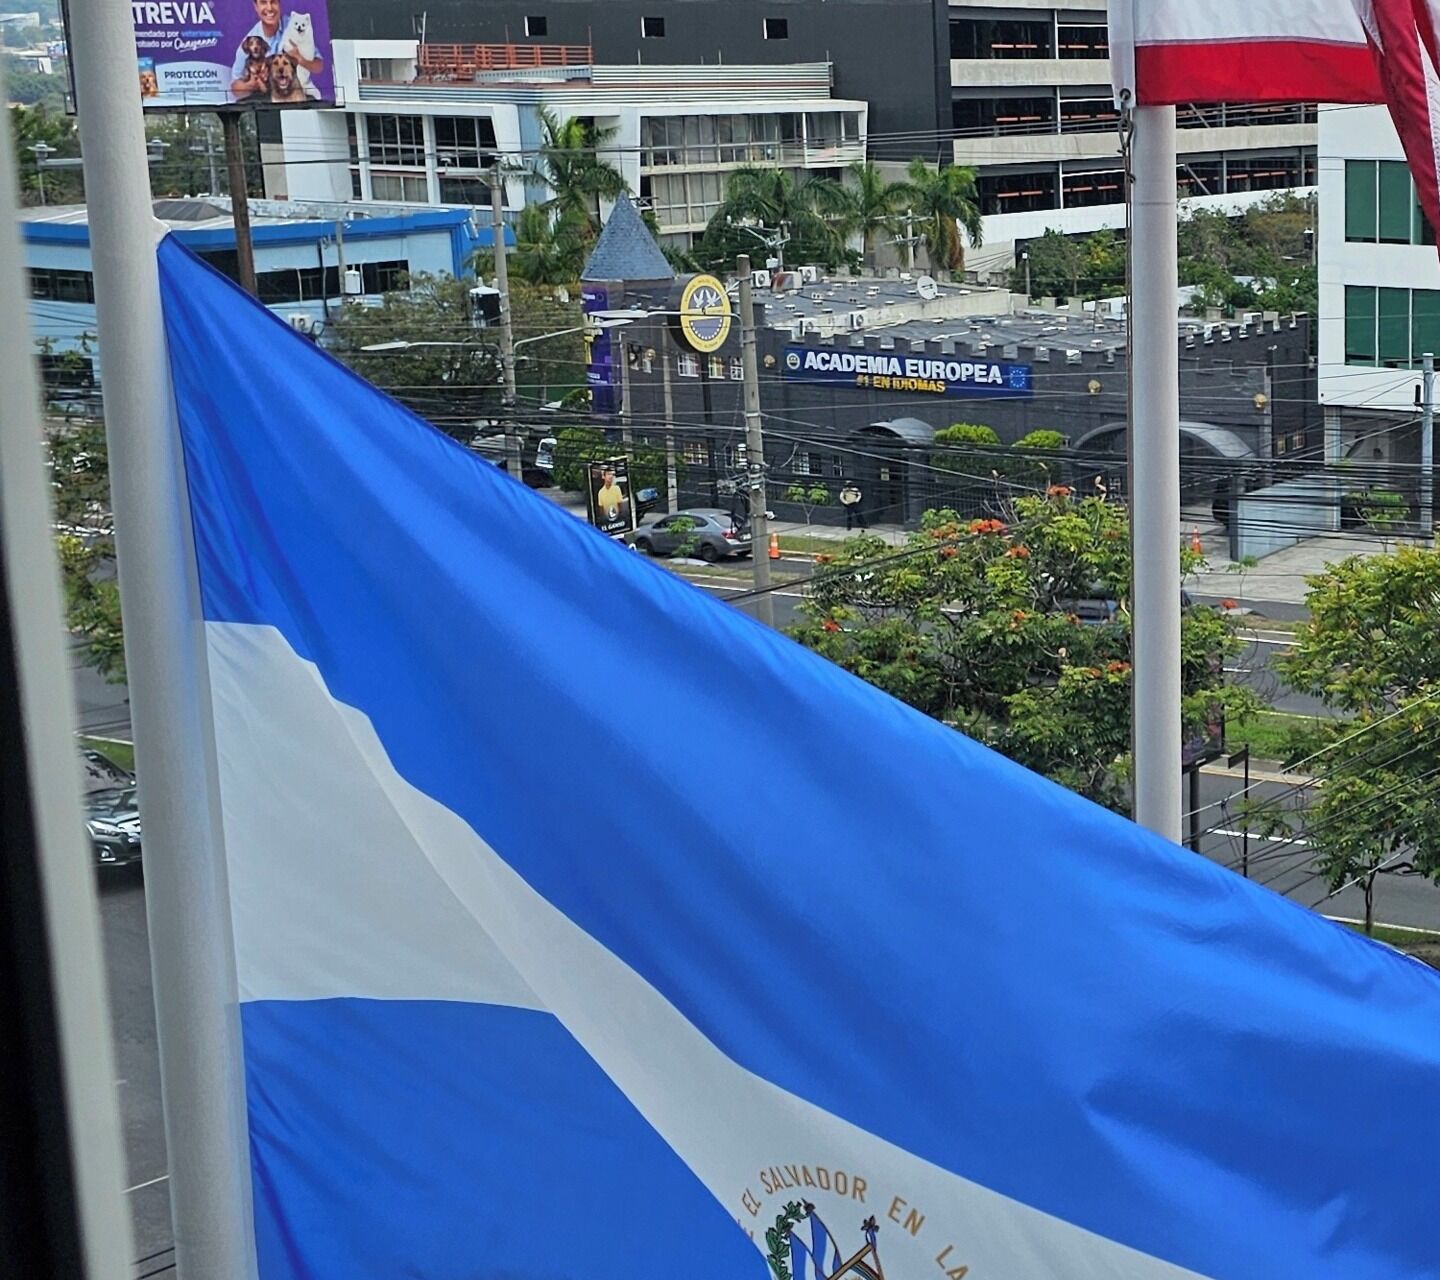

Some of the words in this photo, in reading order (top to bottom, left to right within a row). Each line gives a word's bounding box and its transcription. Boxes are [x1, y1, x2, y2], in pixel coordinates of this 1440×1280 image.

[132, 1, 216, 24] TREVIA
[164, 69, 218, 79] PROTECCIÓN
[804, 351, 902, 376] ACADEMIA
[905, 358, 1003, 384] EUROPEA
[873, 376, 890, 389] EN
[893, 378, 946, 393] IDIOMAS
[742, 1187, 762, 1217] EL
[760, 1165, 867, 1203] SALVADOR
[888, 1195, 926, 1237] EN
